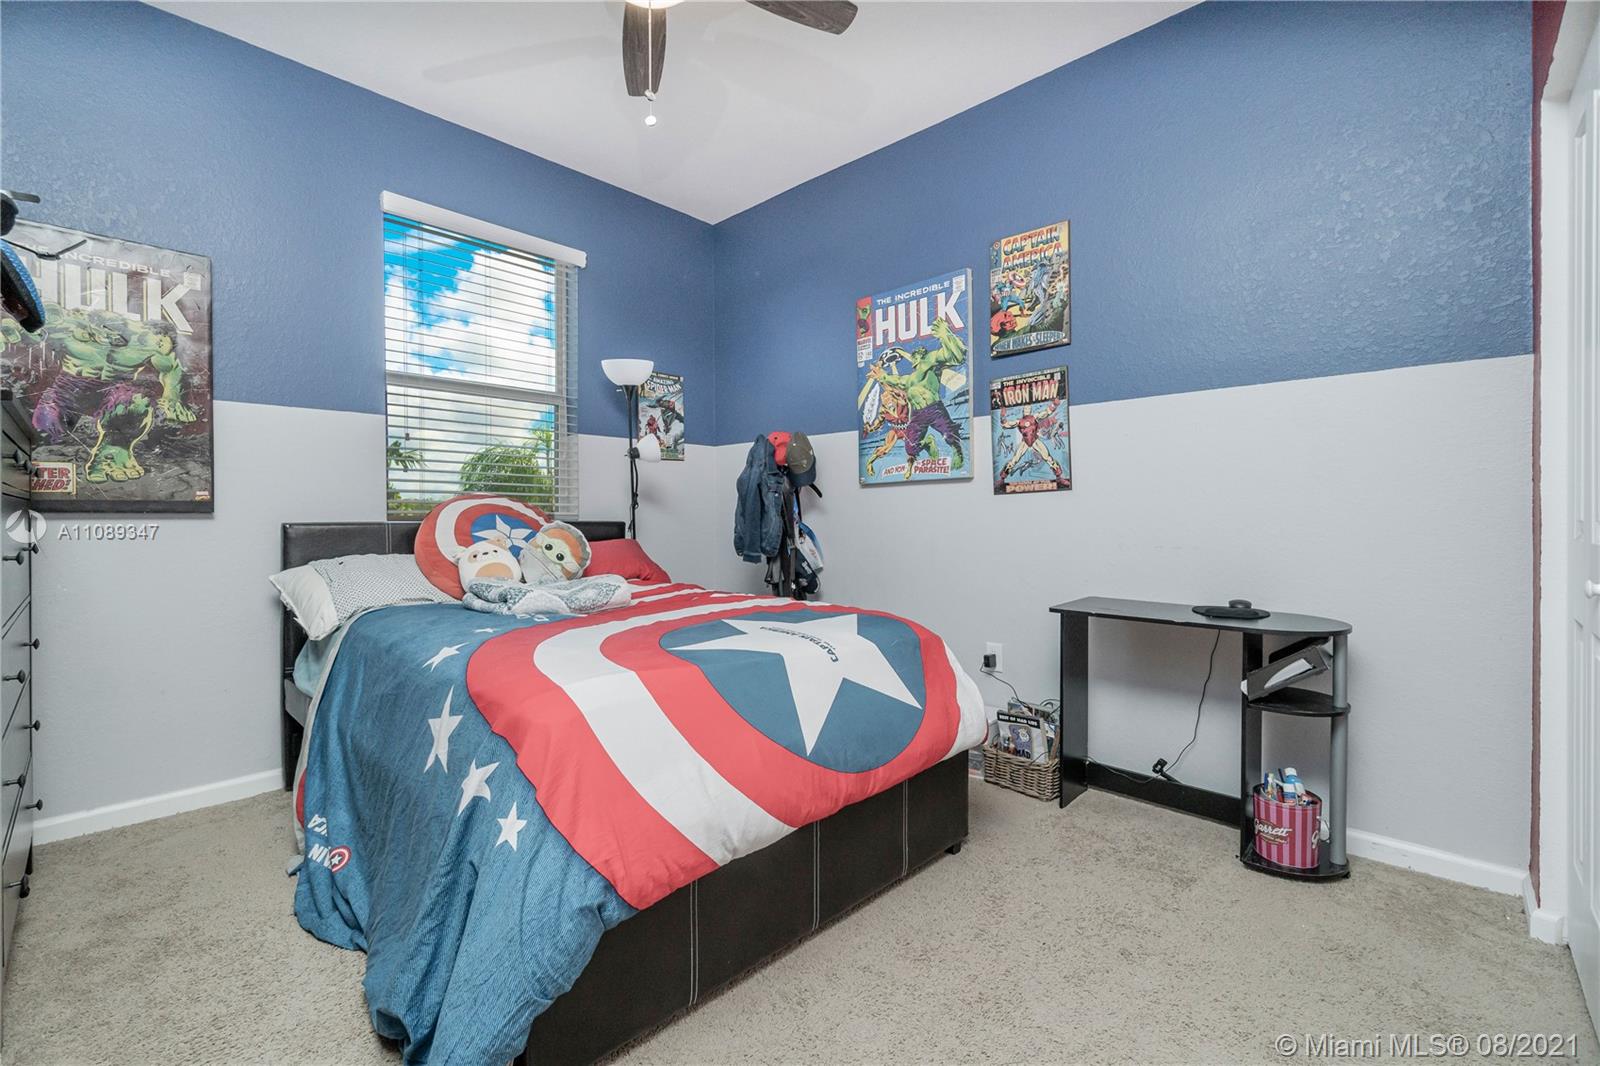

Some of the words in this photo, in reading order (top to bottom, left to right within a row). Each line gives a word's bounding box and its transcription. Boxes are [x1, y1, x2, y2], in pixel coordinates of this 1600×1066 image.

[1003, 226, 1060, 256] CAPTAIN
[1002, 242, 1063, 274] AMERICA
[877, 297, 891, 305] THE
[895, 280, 950, 301] INCREDIBLE
[875, 292, 964, 346] HULK
[1003, 383, 1029, 406] IRON
[1032, 379, 1059, 402] MAN
[1016, 374, 1051, 385] INVINCIBLE
[914, 465, 950, 474] PARASITE!
[921, 457, 947, 467] SPACE
